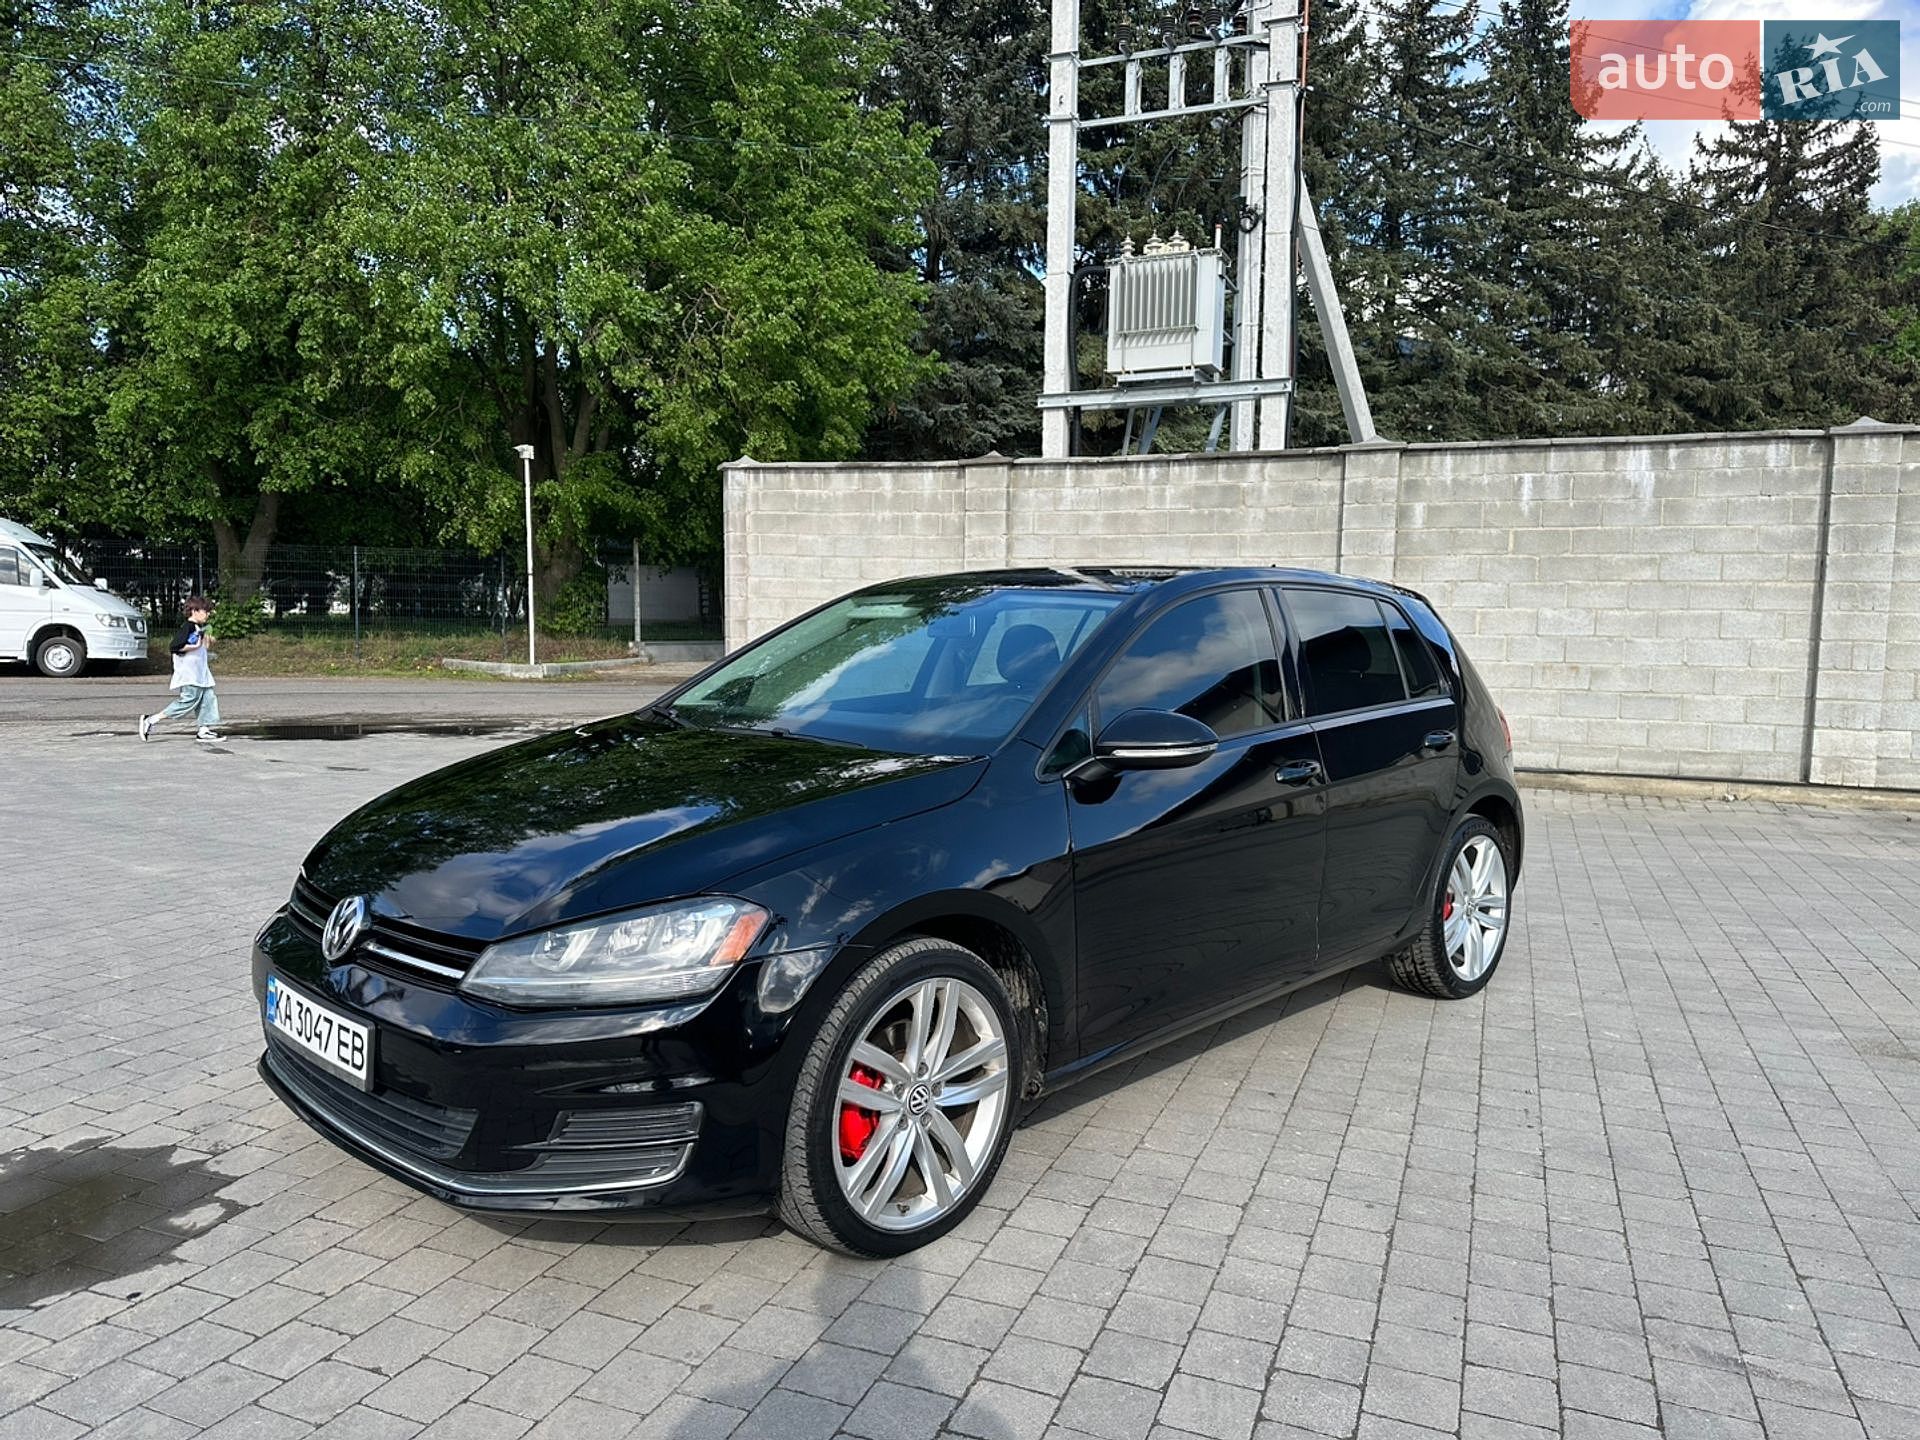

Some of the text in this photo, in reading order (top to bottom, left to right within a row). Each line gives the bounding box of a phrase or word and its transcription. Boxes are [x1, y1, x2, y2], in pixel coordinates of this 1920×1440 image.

[275, 986, 364, 1071] KA 3047 EB
